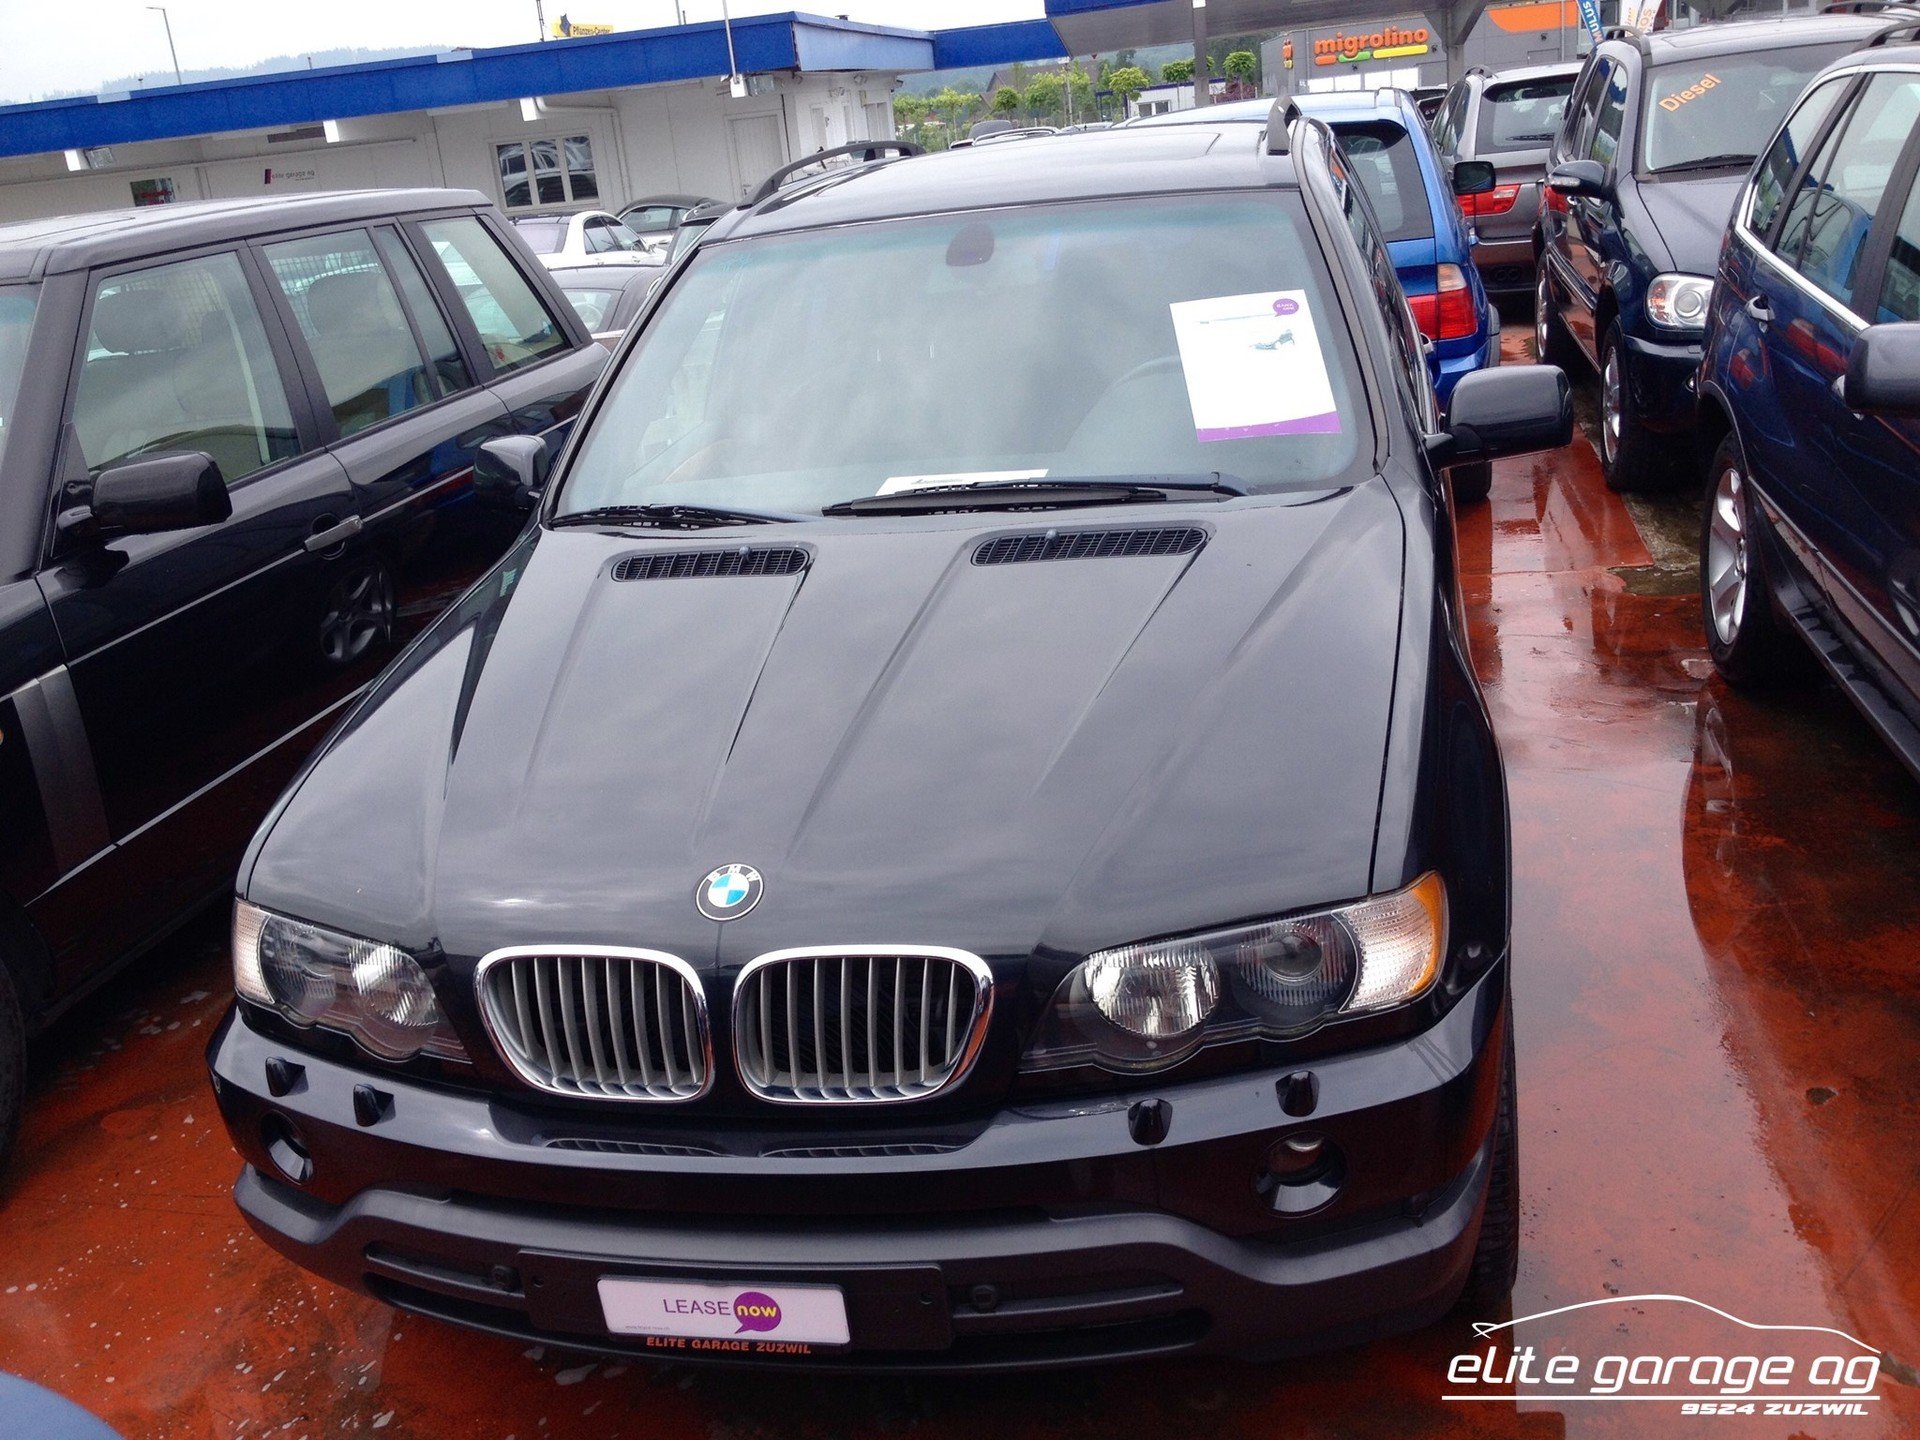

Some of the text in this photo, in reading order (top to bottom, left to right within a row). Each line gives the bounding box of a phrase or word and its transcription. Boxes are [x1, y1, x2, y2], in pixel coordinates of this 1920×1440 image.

[1314, 25, 1429, 58] migrolino
[1658, 73, 1721, 112] Diesel
[662, 1298, 777, 1318] LEASE now
[646, 1336, 811, 1354] ELITE GARAGE ZUZWIL
